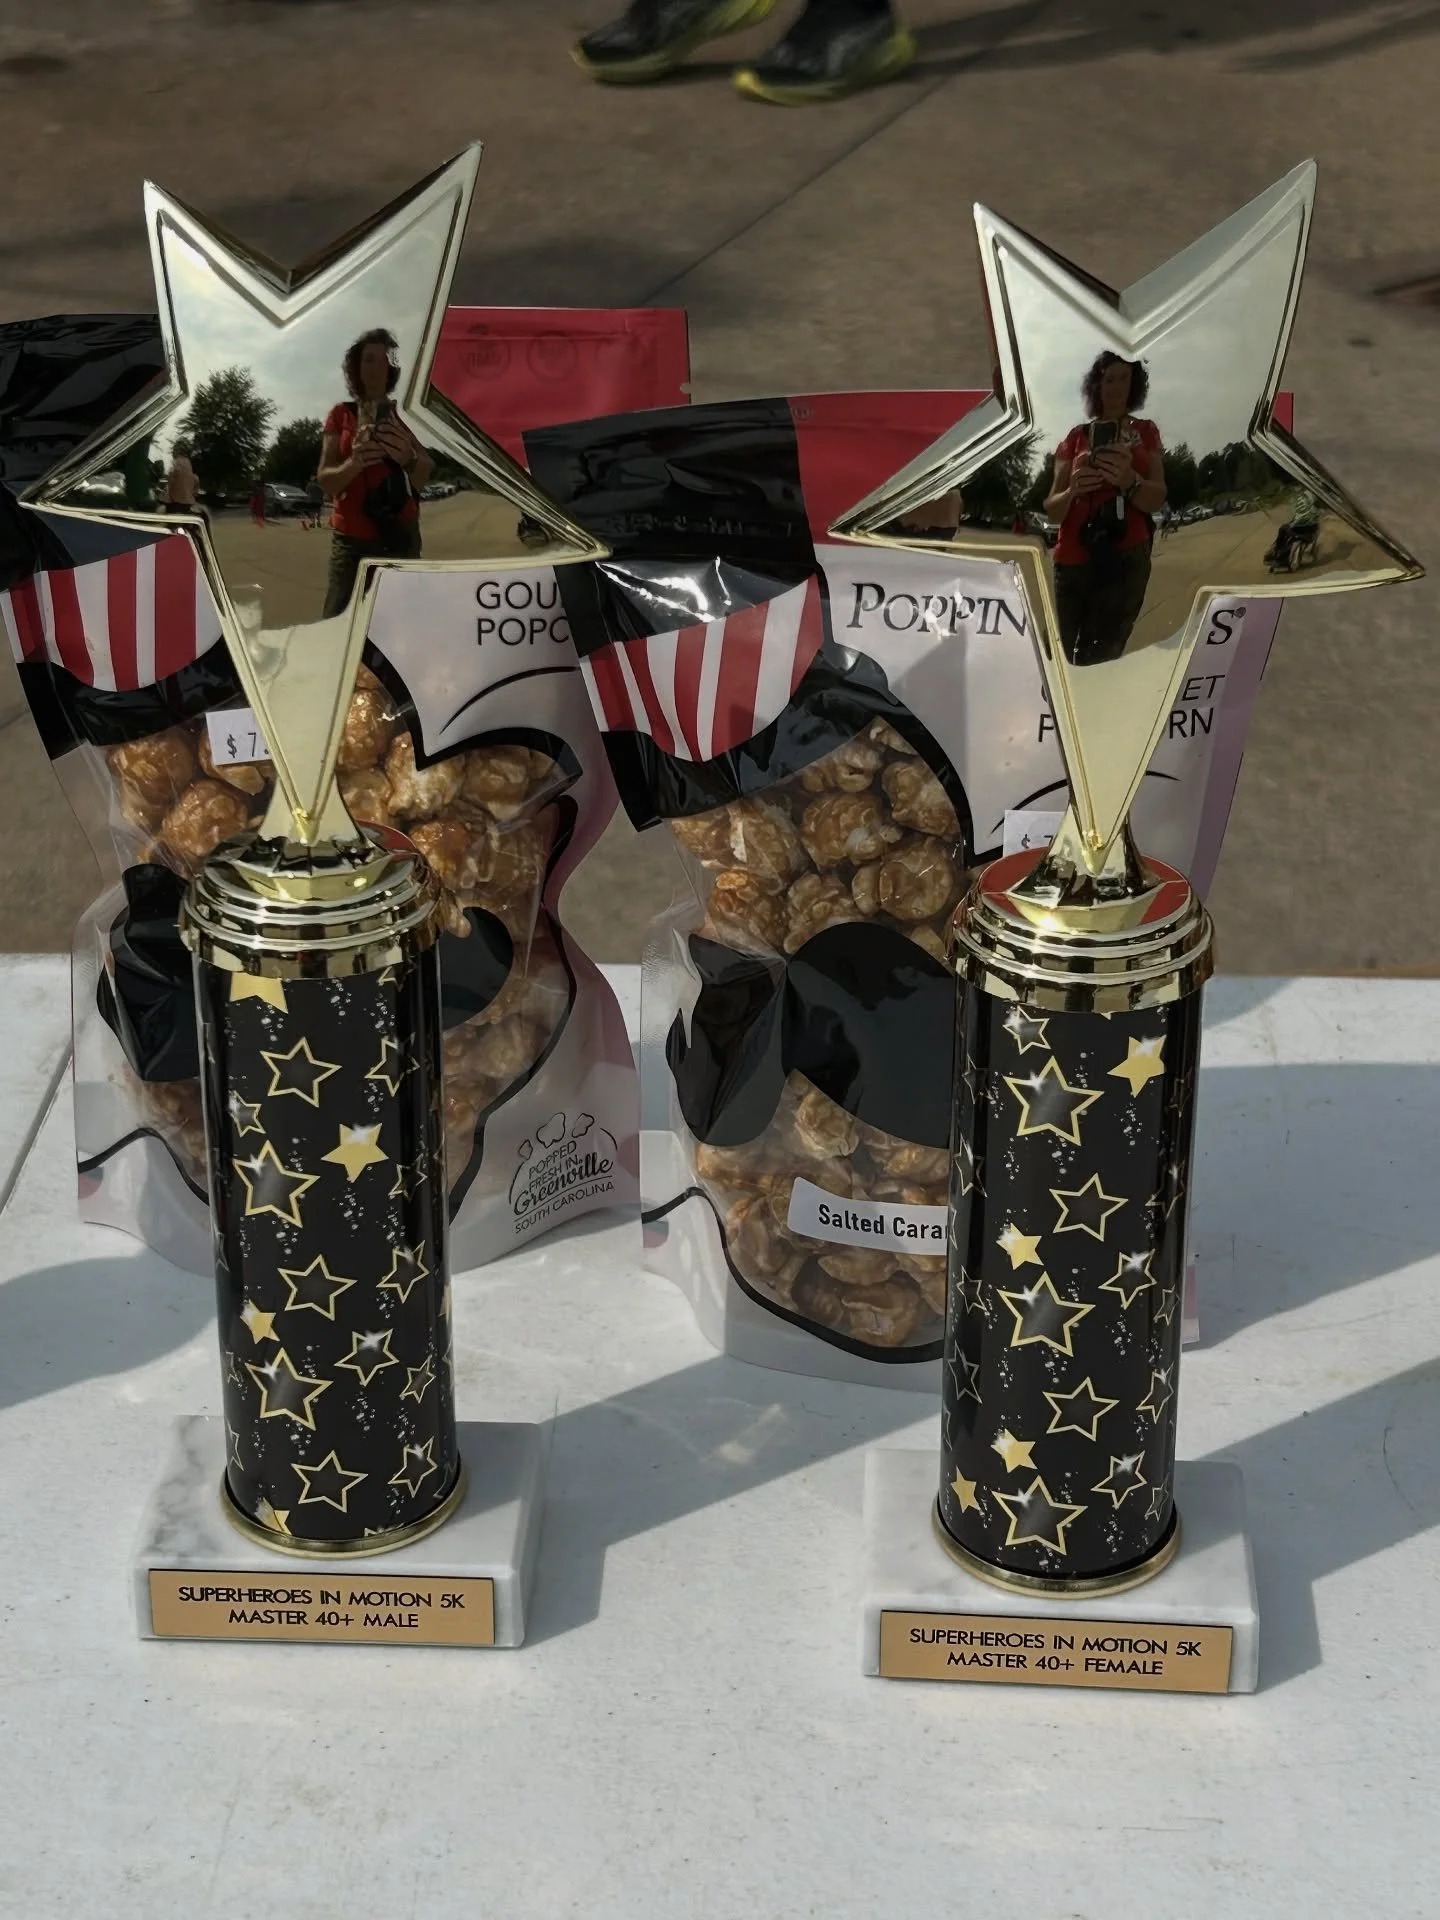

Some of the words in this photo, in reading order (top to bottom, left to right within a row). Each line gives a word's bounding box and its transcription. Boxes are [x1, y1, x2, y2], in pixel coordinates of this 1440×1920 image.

[528, 1140, 577, 1180] POPPED
[513, 1151, 613, 1216] Greenville
[528, 1165, 561, 1194] FRESH
[515, 1205, 551, 1234] SOUTH
[552, 1181, 615, 1212] CAROLINA
[818, 1203, 885, 1235] Salted
[893, 1216, 948, 1240] Cara
[178, 1586, 313, 1605] SUPERHEROES
[320, 1590, 341, 1605] IN
[348, 1591, 432, 1607] MOTION
[440, 1593, 465, 1609] 5K
[228, 1609, 309, 1625] MASTER
[315, 1611, 354, 1626] 40+
[363, 1613, 419, 1628] MALE
[909, 1628, 1045, 1649] SUPERHEROES
[1053, 1635, 1075, 1650] IN
[1081, 1637, 1168, 1655] MOTION
[1176, 1641, 1202, 1657] 5K
[946, 1651, 1028, 1669] MASTER
[1035, 1655, 1075, 1671] 40+
[1084, 1657, 1164, 1675] FEMALE
